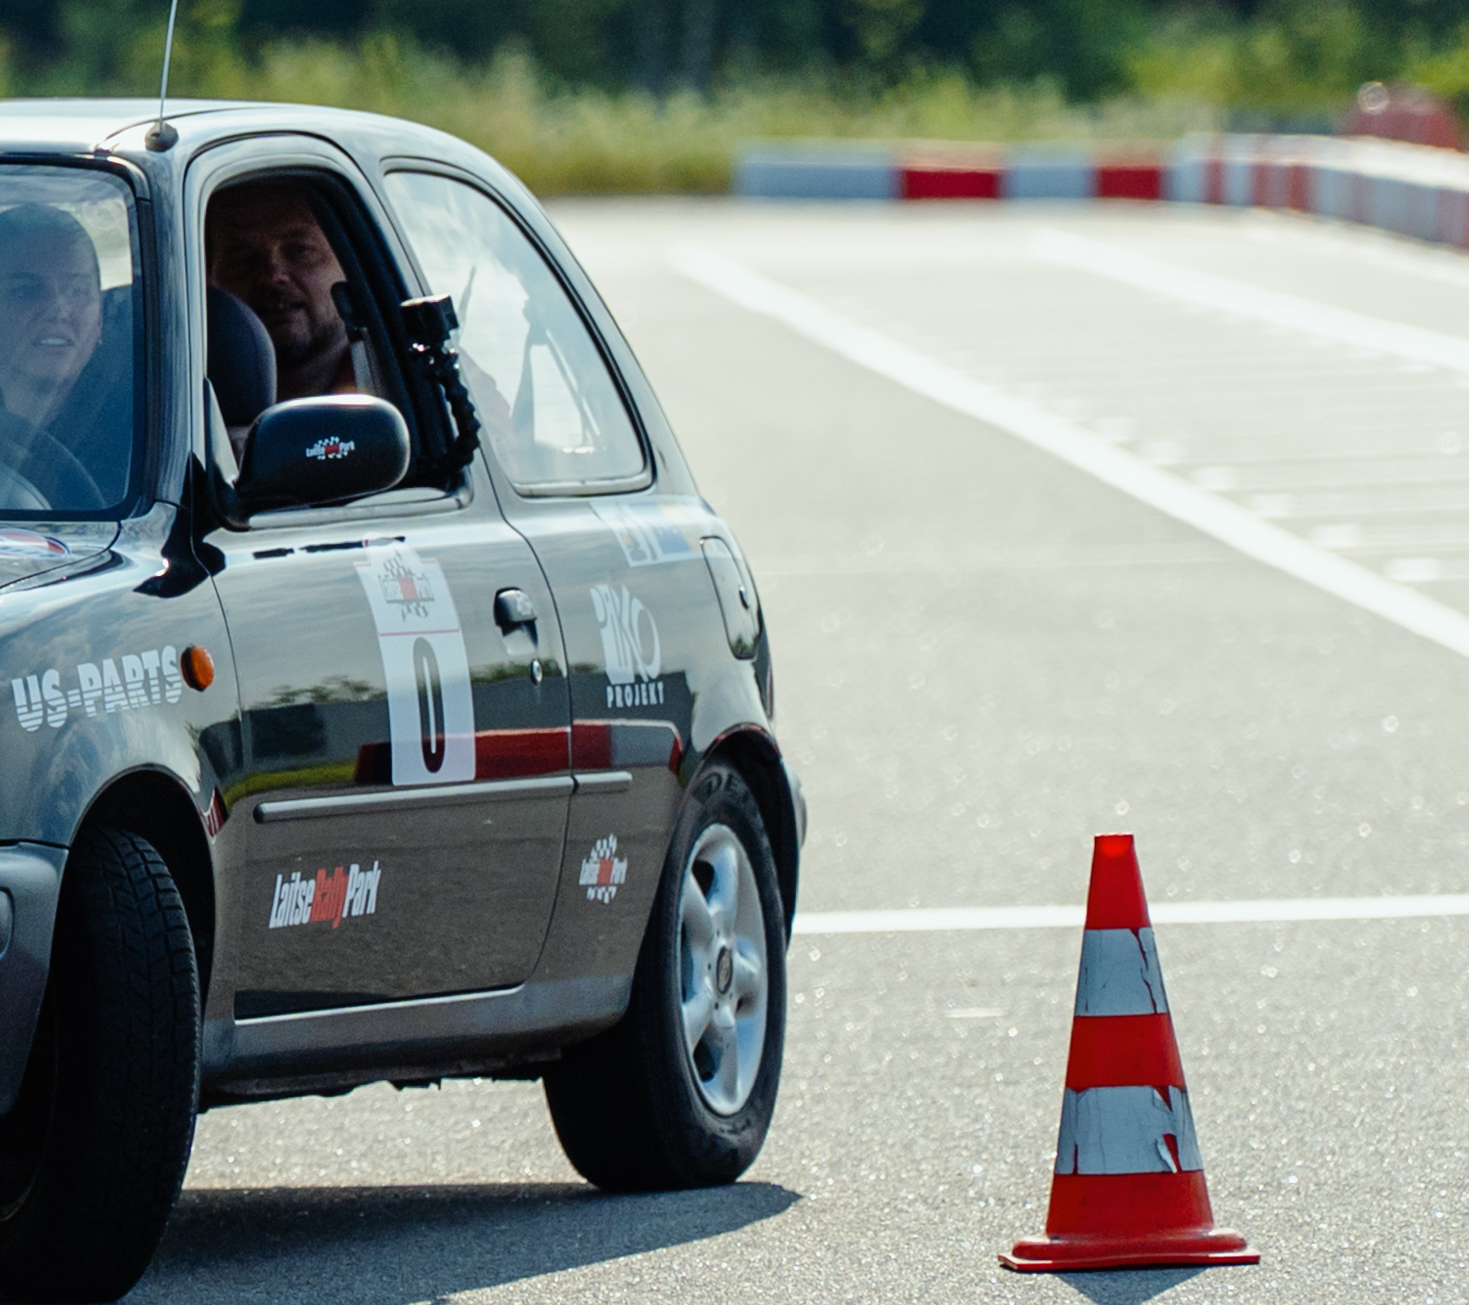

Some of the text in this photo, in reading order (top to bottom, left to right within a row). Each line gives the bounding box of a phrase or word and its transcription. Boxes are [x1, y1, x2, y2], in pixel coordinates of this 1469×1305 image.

[11, 645, 183, 732] US-PARTS
[413, 637, 445, 774] 0
[606, 681, 664, 709] PROJEKT
